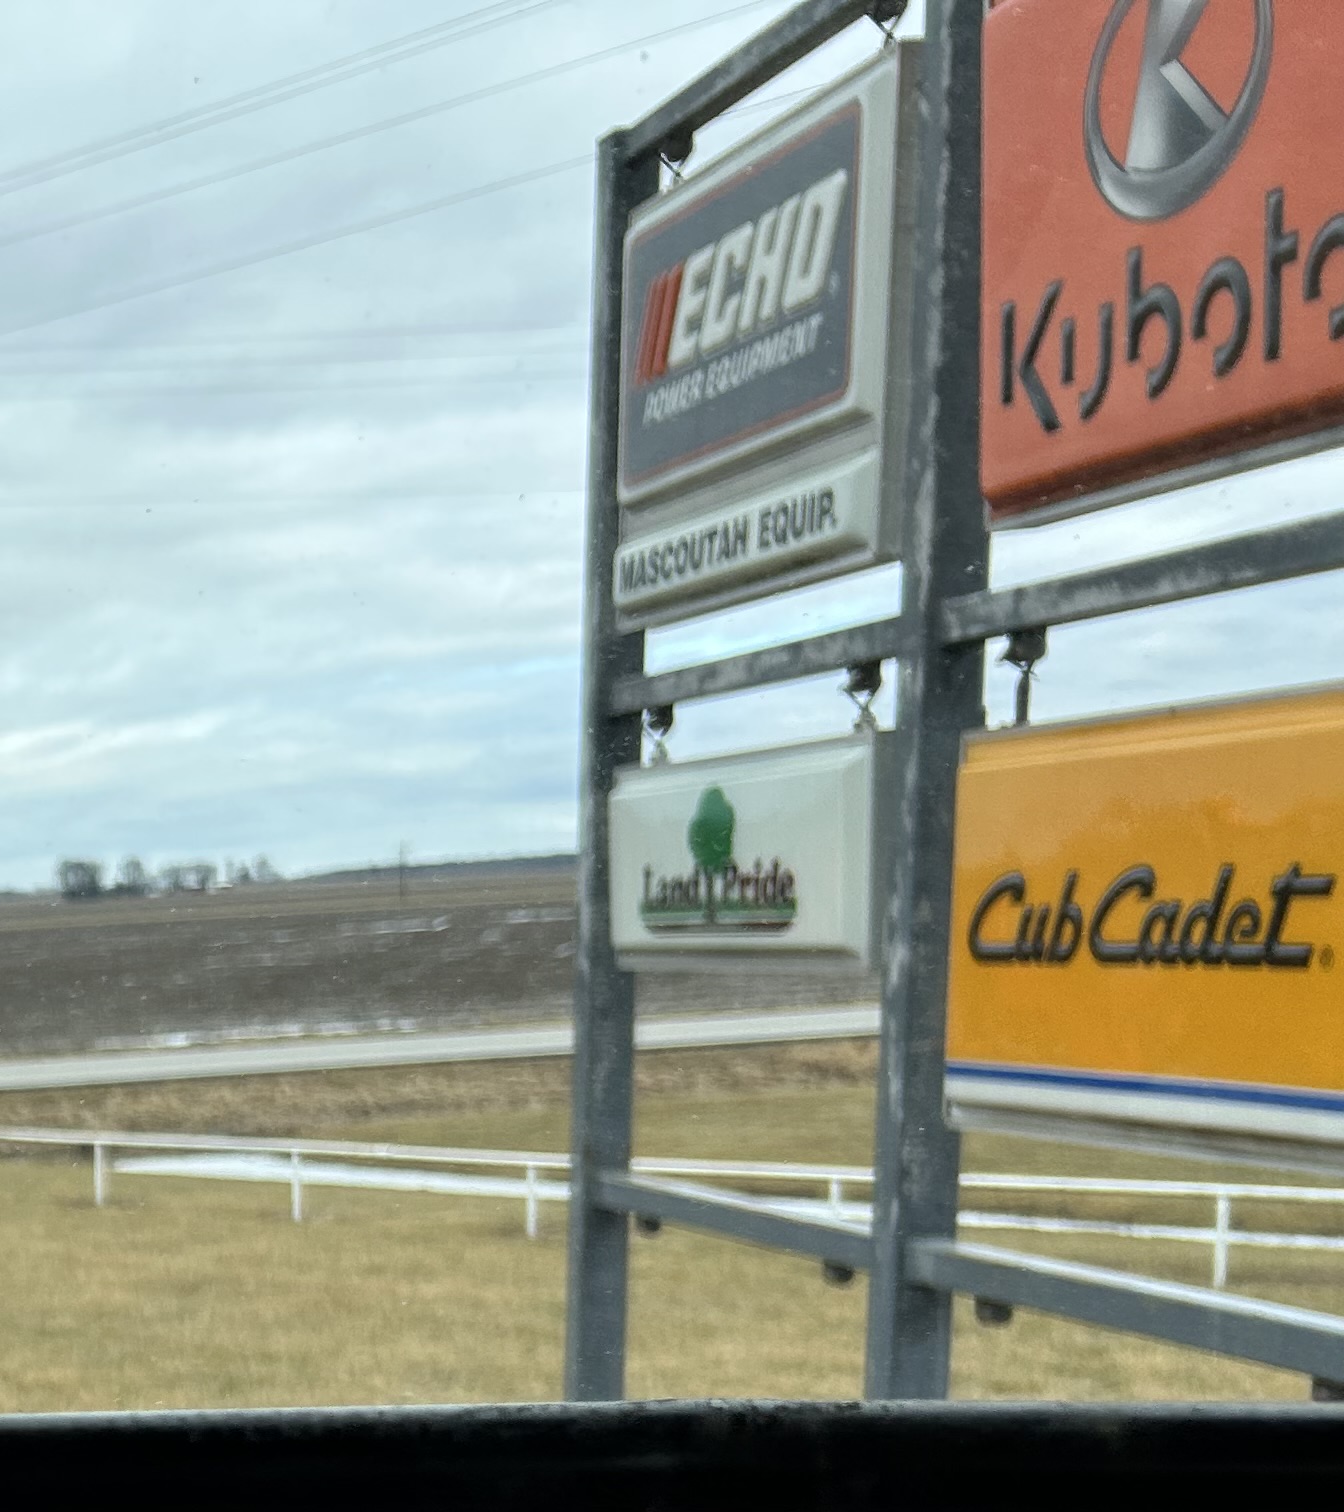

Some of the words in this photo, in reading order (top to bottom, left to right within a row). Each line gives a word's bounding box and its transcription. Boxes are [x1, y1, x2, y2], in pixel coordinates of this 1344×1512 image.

[667, 167, 849, 369] ECHO
[643, 366, 705, 426] POWER
[705, 311, 824, 399] EQUIPMENT
[618, 514, 748, 592] MASCOUTAH
[642, 862, 701, 905] Land
[721, 855, 797, 906] Pride
[967, 870, 1083, 963] Cub
[1088, 862, 1335, 967] Cadet
